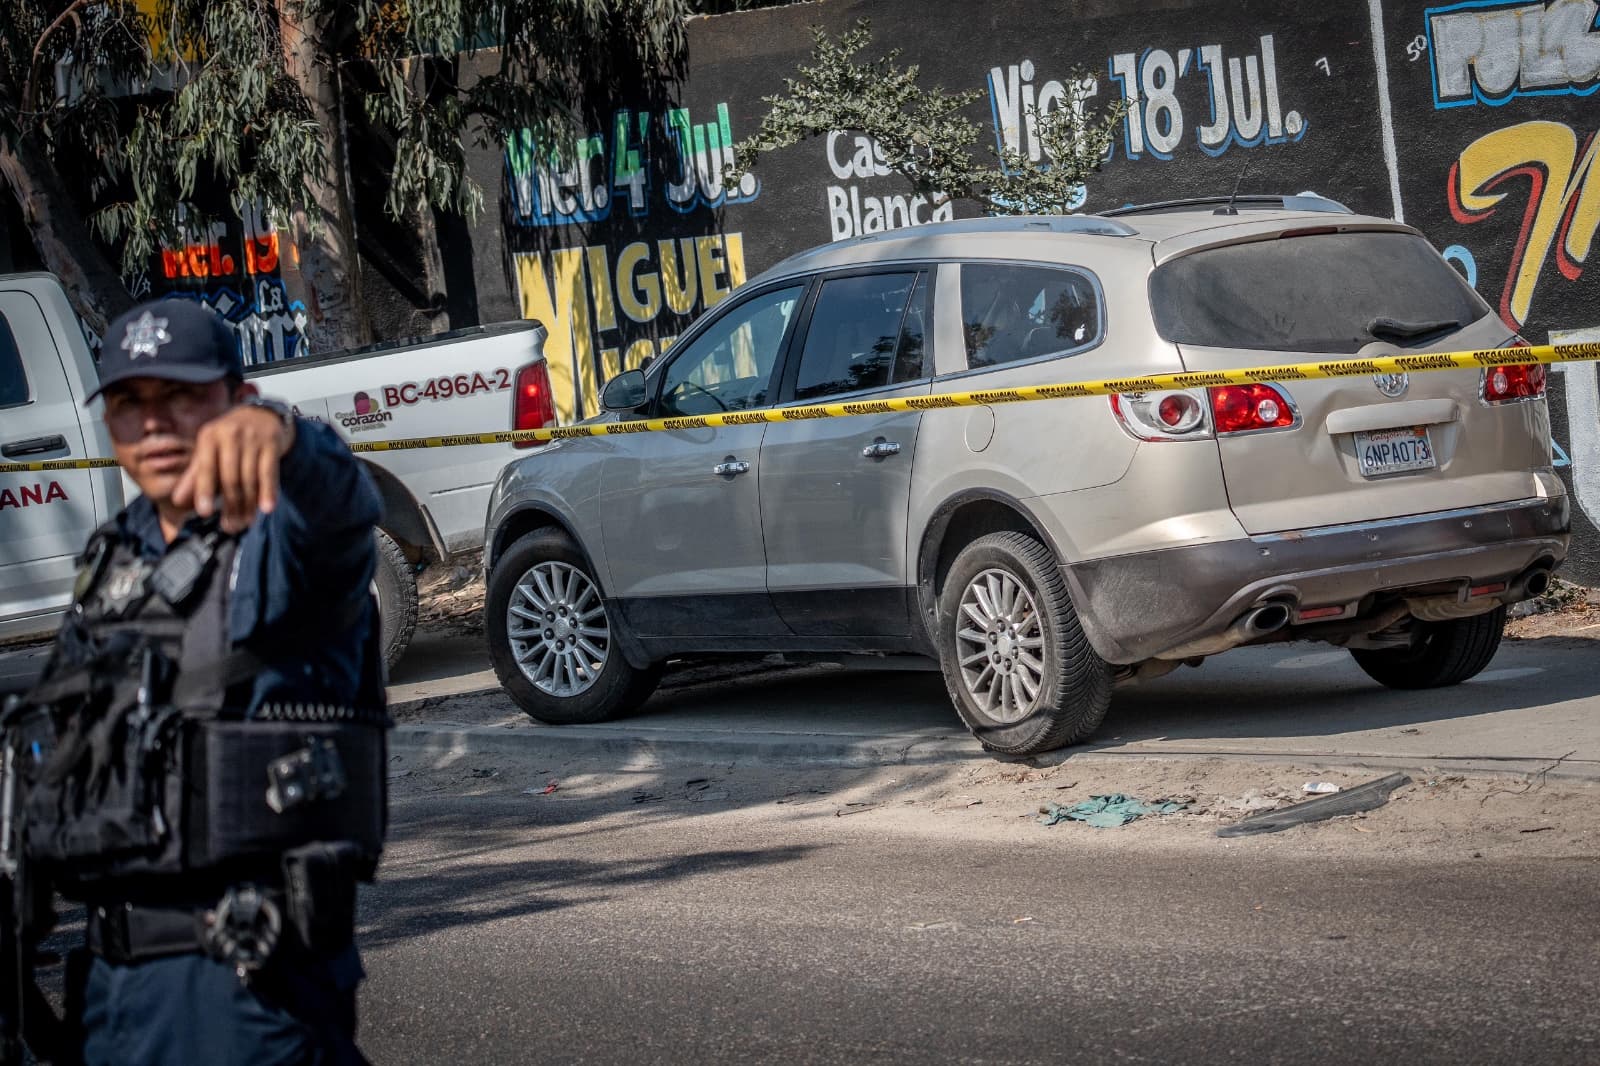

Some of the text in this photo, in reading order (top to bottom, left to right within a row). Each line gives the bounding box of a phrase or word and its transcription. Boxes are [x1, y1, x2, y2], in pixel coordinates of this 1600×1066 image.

[1200, 34, 1303, 145] Jul.
[384, 368, 512, 408] BC-496A-2
[341, 409, 393, 427] corazón
[1365, 439, 1429, 467] 6NPA073
